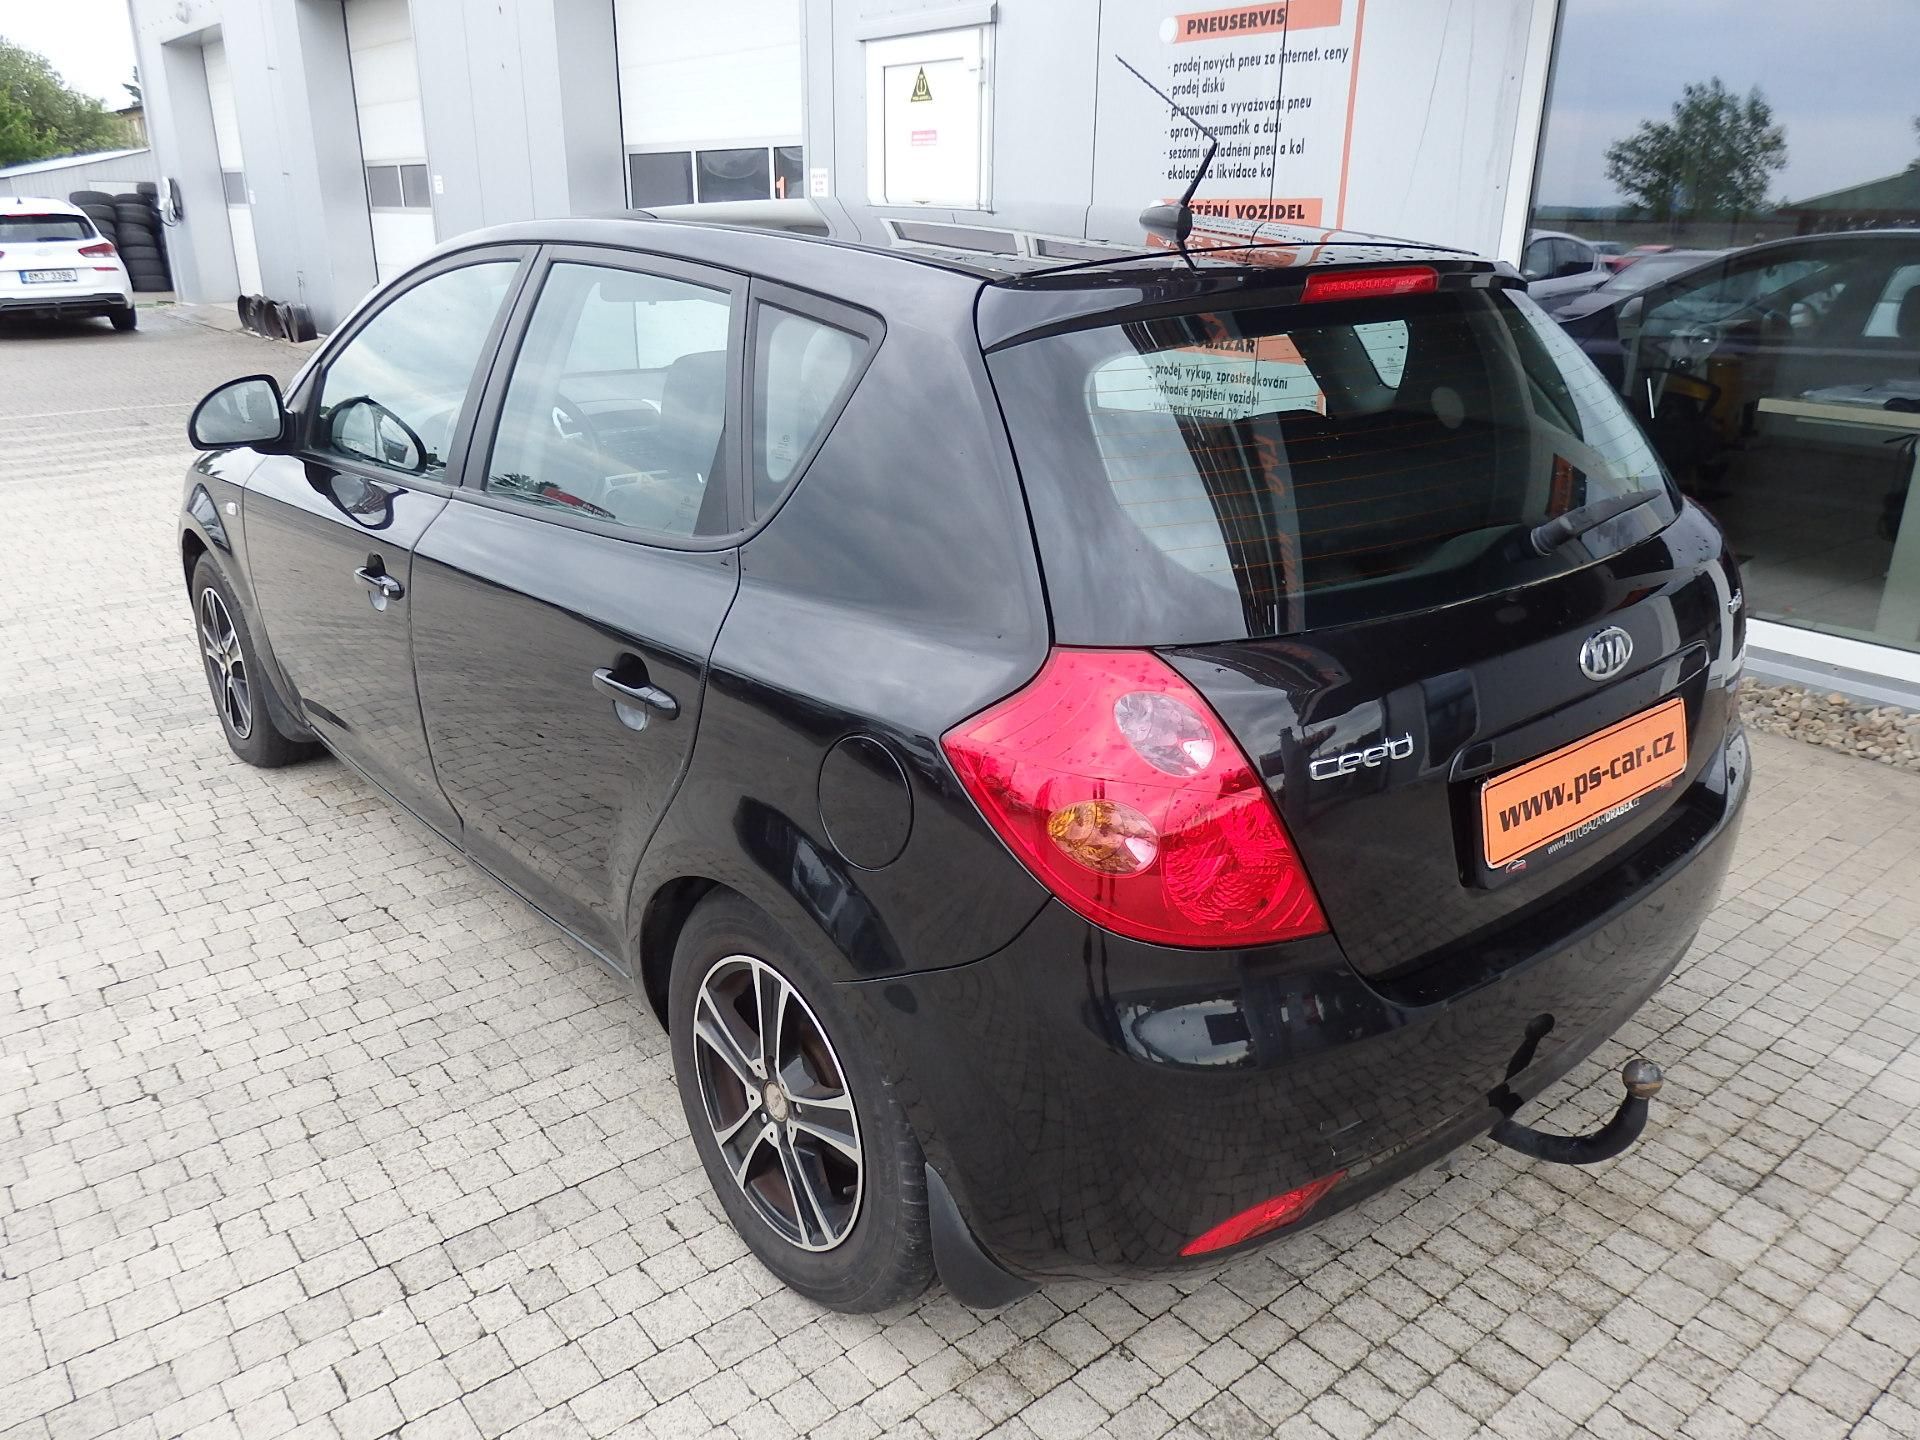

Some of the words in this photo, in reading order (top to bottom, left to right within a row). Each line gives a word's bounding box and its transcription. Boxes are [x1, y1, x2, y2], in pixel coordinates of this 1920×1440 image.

[1186, 8, 1286, 35] PNEUSERVIS
[1173, 56, 1201, 77] prodej
[1203, 53, 1235, 73] nových
[1238, 54, 1261, 72] pneu
[1264, 53, 1276, 65] za
[1324, 47, 1350, 62] ceny
[1172, 78, 1200, 99] prodej
[1221, 103, 1227, 114] a
[1288, 97, 1312, 113] pneu
[1170, 126, 1199, 143] opravy
[1202, 119, 1250, 140] pneumatik
[1253, 123, 1260, 133] a
[1203, 140, 1251, 158] uladnění
[1254, 144, 1277, 160] pneu
[1280, 144, 1286, 155] a
[1290, 138, 1305, 155] kol
[1216, 160, 1257, 179] likvidace
[1260, 162, 1275, 178] ko
[1235, 204, 1306, 220] VOZIDEL
[1229, 391, 1260, 407] vozidel
[1592, 634, 1626, 673] KIA
[1499, 731, 1676, 833] www.ps-car.cz
